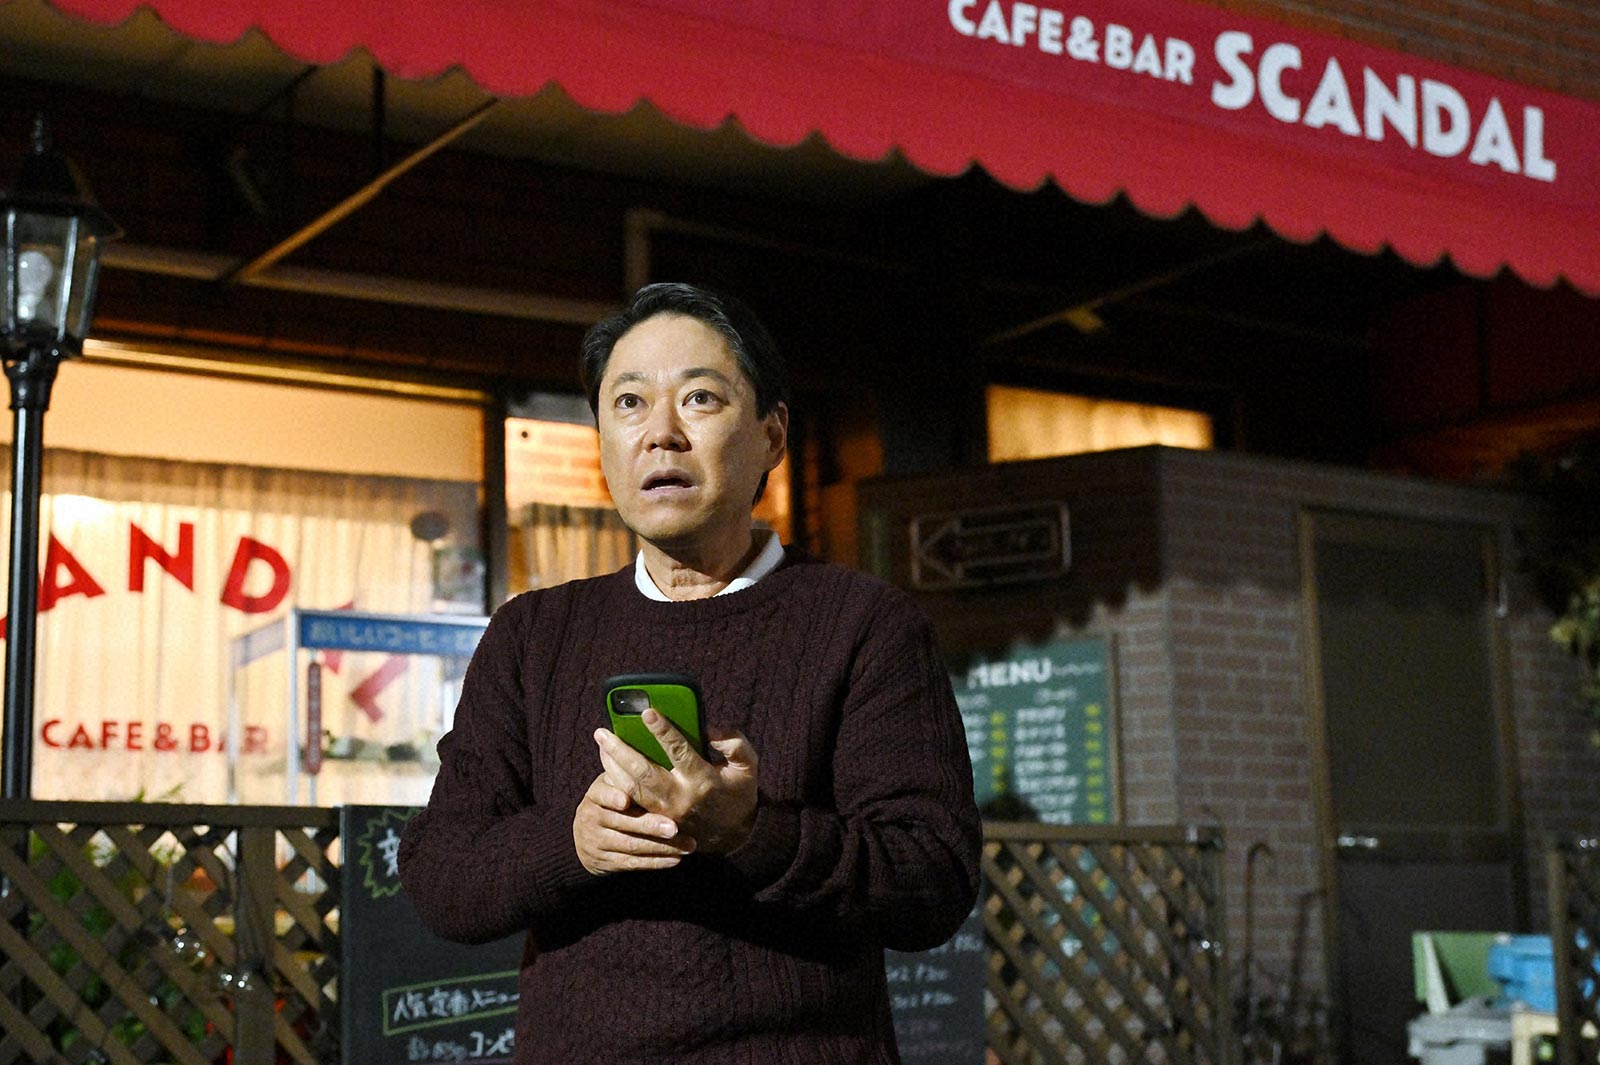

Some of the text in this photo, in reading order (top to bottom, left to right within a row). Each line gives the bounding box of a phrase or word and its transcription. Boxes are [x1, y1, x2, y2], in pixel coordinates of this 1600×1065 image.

[948, 0, 1557, 182] CAFE&BAR SCANDAL
[41, 717, 268, 753] CAFE&BR
